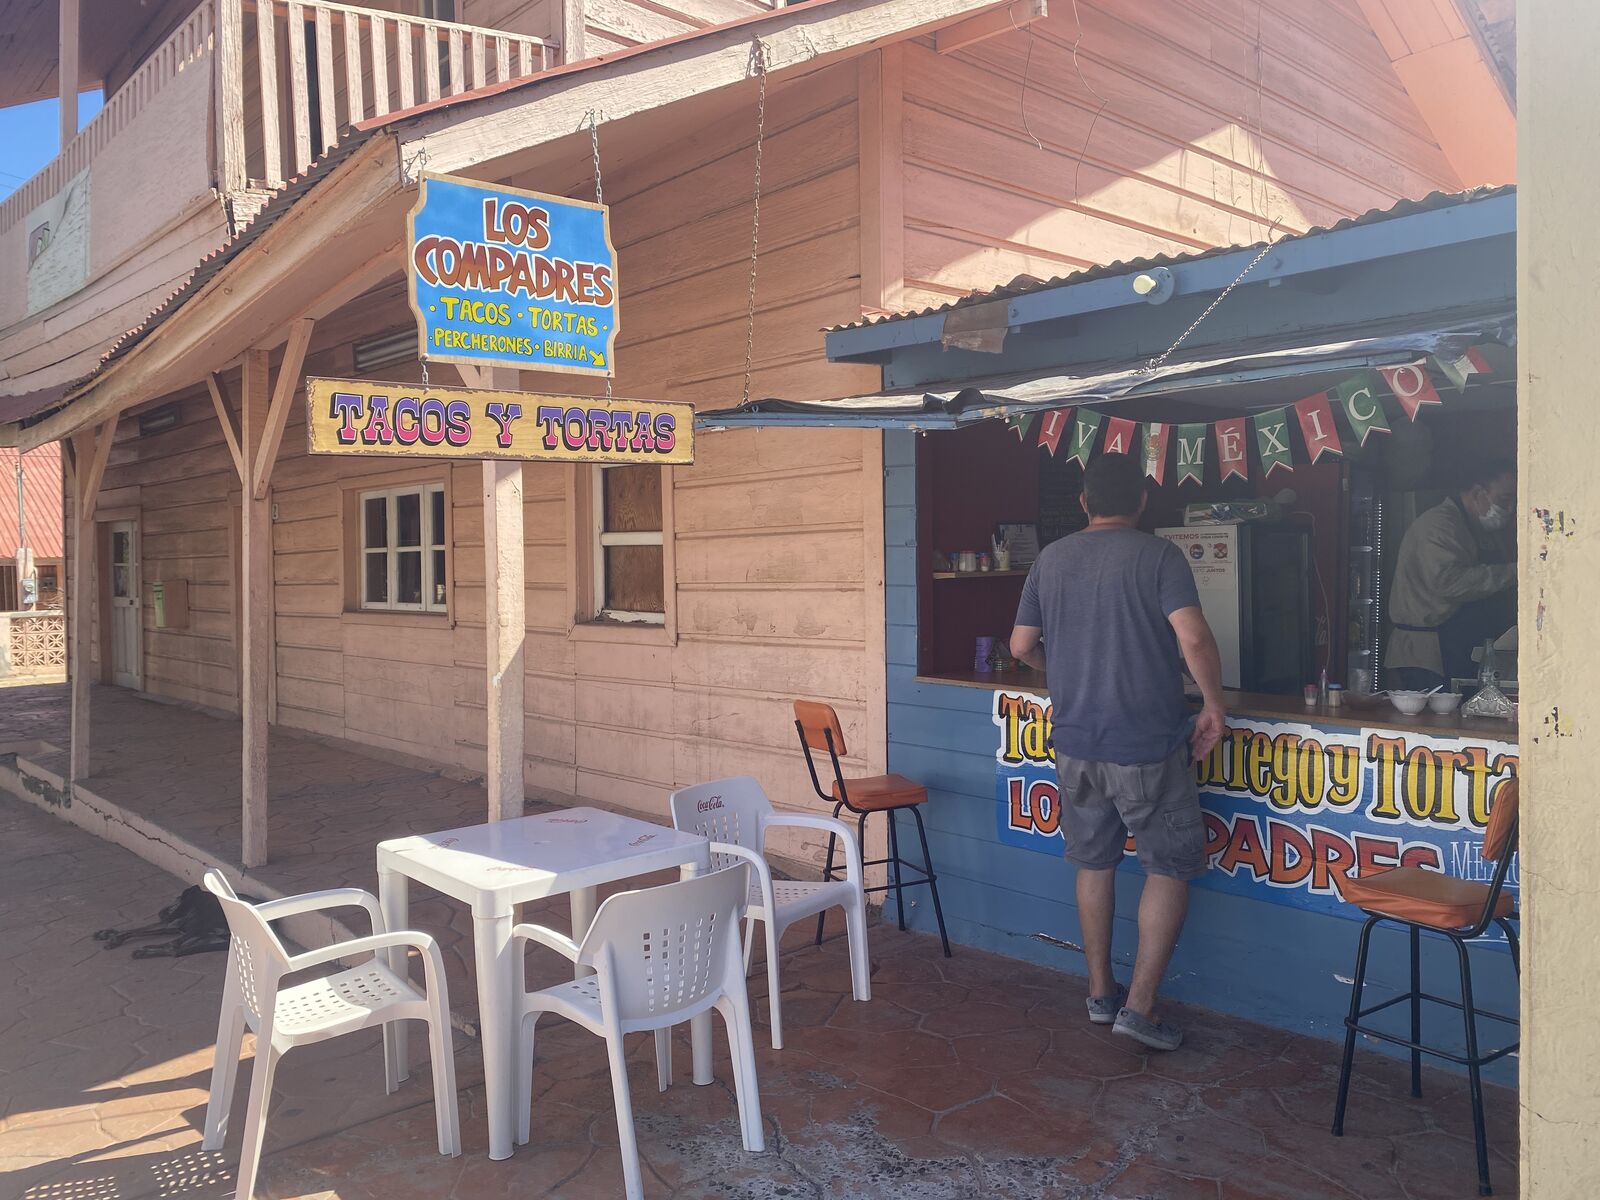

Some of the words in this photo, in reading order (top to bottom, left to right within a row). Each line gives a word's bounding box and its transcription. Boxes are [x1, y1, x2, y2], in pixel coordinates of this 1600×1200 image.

[484, 198, 550, 250] LOS
[414, 235, 614, 306] COMPADRES
[434, 327, 533, 356] PERCHERONES
[543, 340, 588, 362] BIRRIA
[440, 296, 512, 326] TACOS
[528, 306, 599, 337] TORTAS
[330, 392, 472, 447] TACOS
[486, 403, 522, 448] Y
[537, 406, 676, 453] TORTAS
[1019, 409, 1122, 454] IVA
[1178, 364, 1425, 466] MÉXICO
[999, 692, 1057, 764] Ta
[1009, 778, 1062, 835] LO
